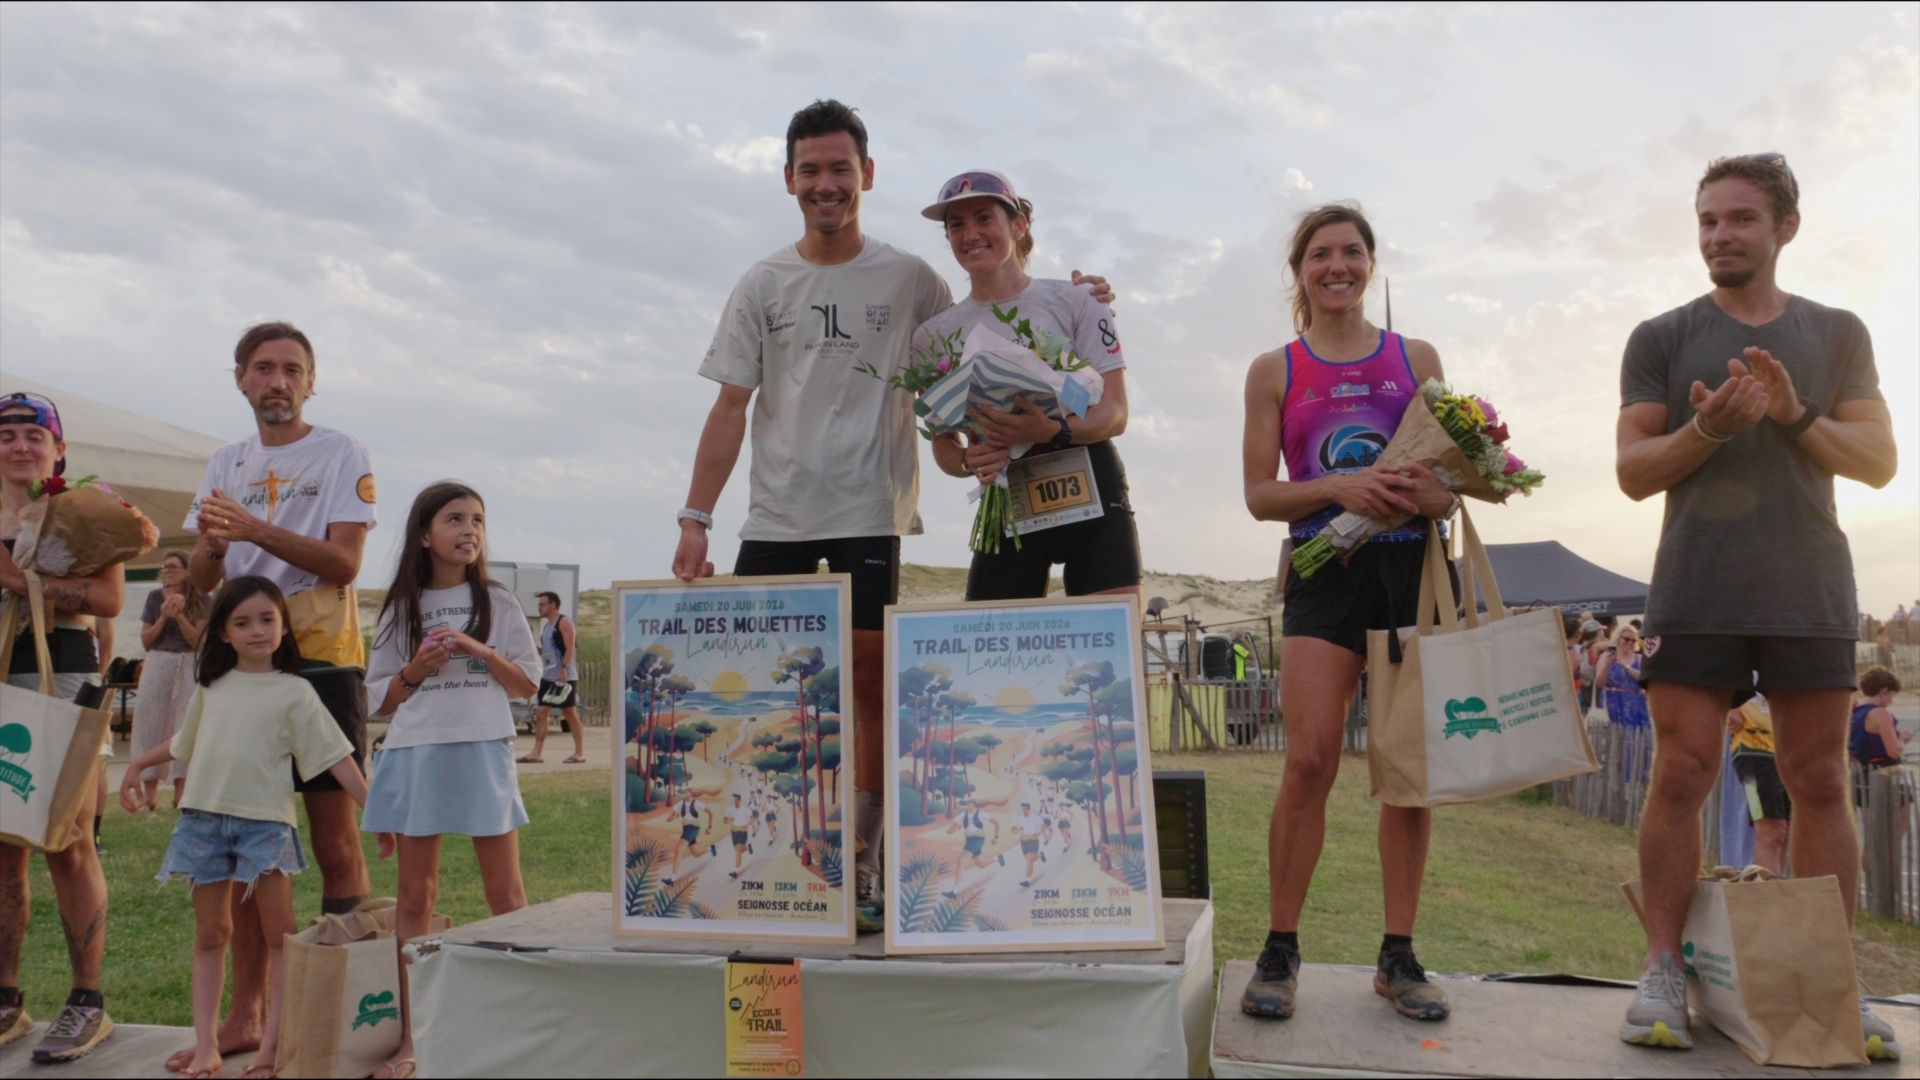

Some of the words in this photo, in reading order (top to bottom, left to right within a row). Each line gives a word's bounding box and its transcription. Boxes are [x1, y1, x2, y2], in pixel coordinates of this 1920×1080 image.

[866, 318, 890, 326] HEART
[834, 341, 860, 349] LAND
[1035, 476, 1082, 503] 1073
[436, 606, 474, 618] STRENG
[675, 602, 714, 613] SAMEDI
[717, 601, 730, 612] 20
[732, 600, 756, 612] JUIN
[759, 599, 785, 611] 2026
[638, 618, 687, 635] TRAIL
[694, 617, 727, 634] DES
[733, 615, 827, 634] MOUETTES
[953, 623, 995, 634] SAMEDI
[998, 622, 1012, 632] 20
[1015, 620, 1040, 632] JUIN
[1044, 619, 1071, 630] 2026
[686, 626, 769, 659] Landirun
[913, 639, 967, 655] TRAIL
[974, 637, 1010, 653] DES
[1017, 632, 1116, 651] MOUETTES
[966, 645, 1055, 676] Landirun
[420, 682, 441, 692] rom
[443, 680, 462, 689] the
[463, 679, 489, 688] heart
[741, 880, 764, 891] 21KM
[774, 882, 797, 892] 13KM
[1034, 889, 1060, 900] 21KM
[1071, 888, 1097, 898] 13KM
[738, 900, 790, 911] SEIGNOSSE
[793, 899, 828, 912] OCÉAN
[1031, 908, 1090, 919] SEIGNOSSE
[1093, 904, 1132, 918] OCÉAN
[729, 963, 800, 993] Landirun
[752, 1007, 782, 1018] ECOLE
[746, 1018, 787, 1032] TRAIL
